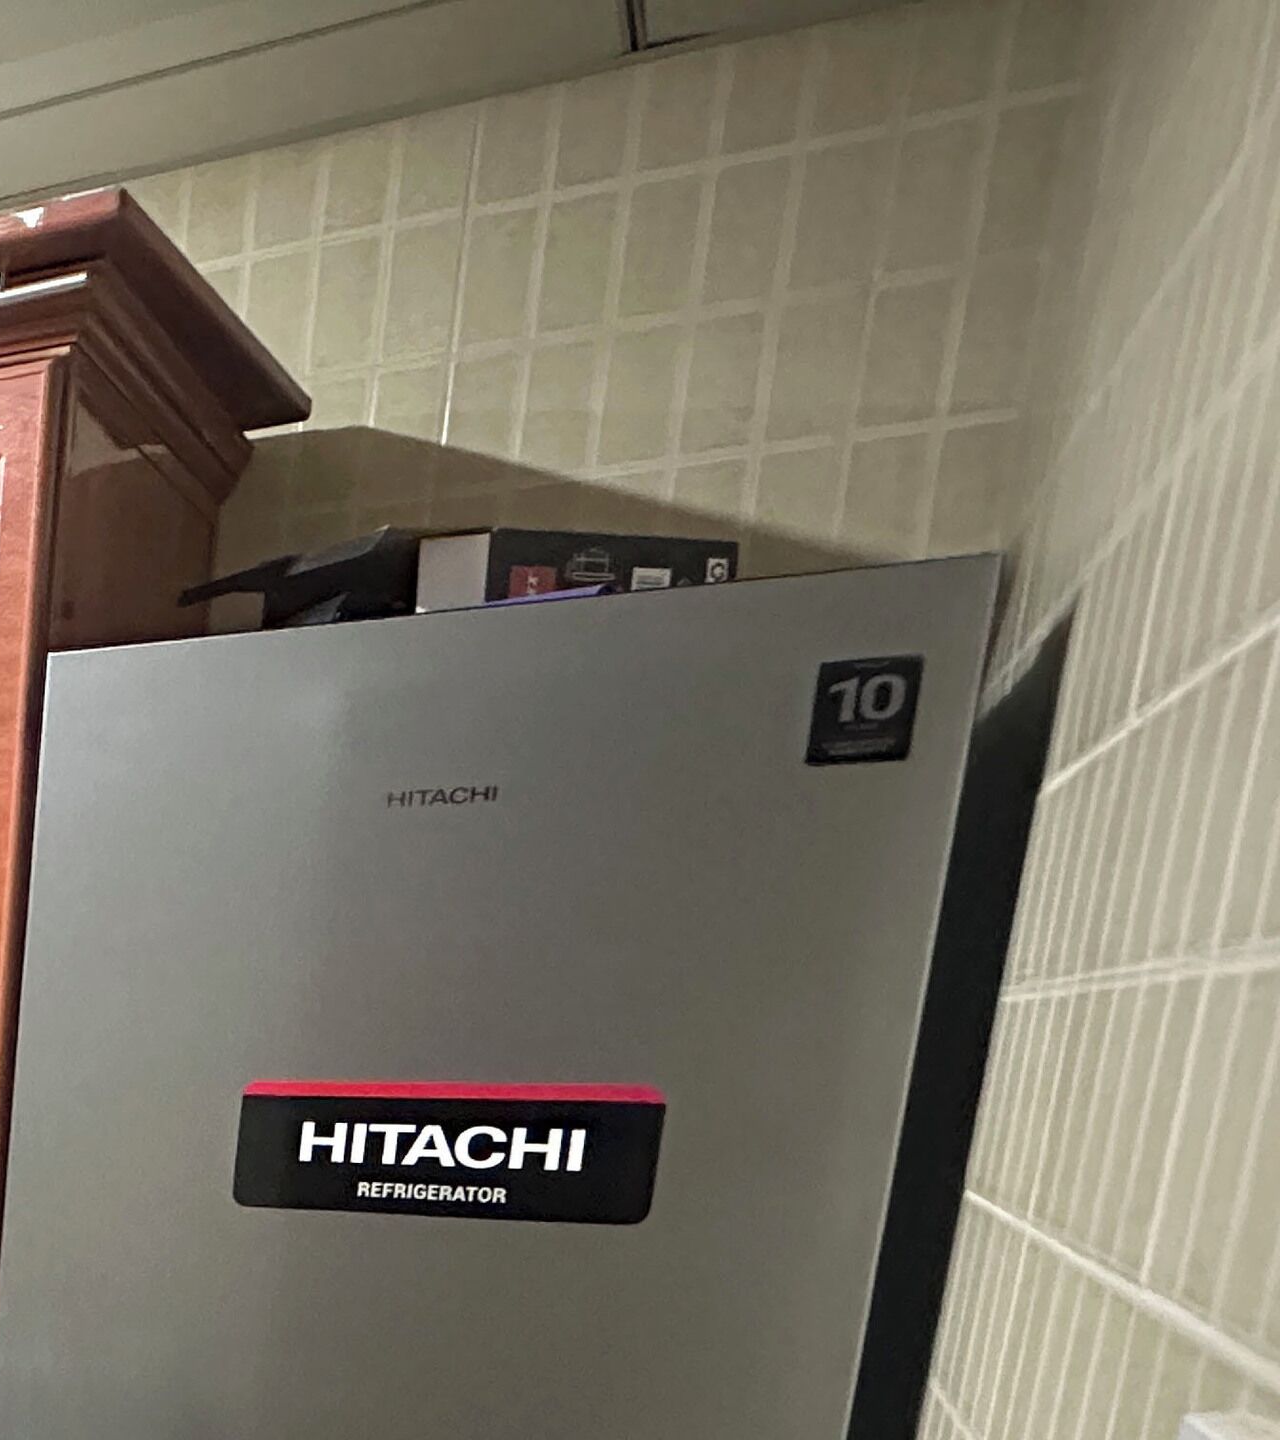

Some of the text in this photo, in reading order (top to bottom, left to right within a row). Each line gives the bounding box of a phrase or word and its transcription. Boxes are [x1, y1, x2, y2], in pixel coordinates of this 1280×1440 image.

[828, 673, 907, 722] 10
[386, 785, 498, 808] HITACHI
[298, 1120, 587, 1172] HITACHI
[356, 1181, 507, 1204] REFRIGERATOR
